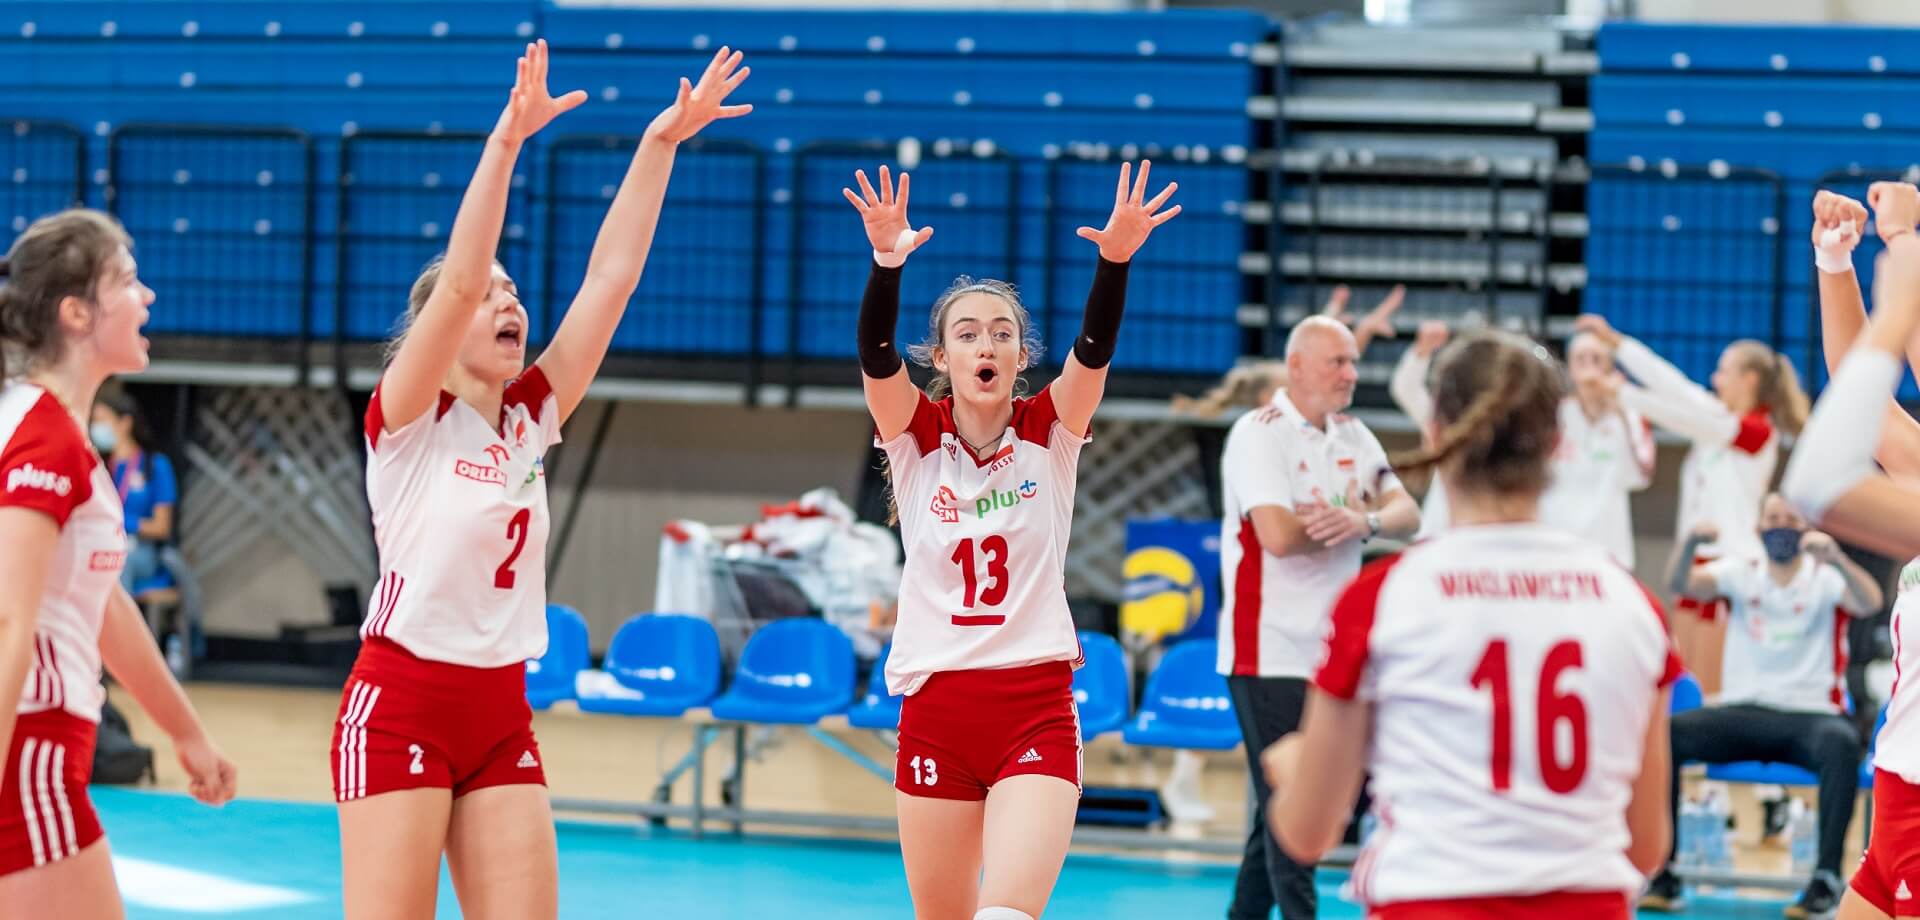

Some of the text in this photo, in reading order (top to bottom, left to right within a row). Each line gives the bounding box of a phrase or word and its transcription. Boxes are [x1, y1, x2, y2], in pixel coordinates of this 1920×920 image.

[7, 463, 58, 492] plus
[987, 455, 1014, 476] OLSK
[976, 489, 1020, 519] plus
[495, 508, 530, 589] 2
[951, 535, 1009, 608] 13
[1470, 639, 1588, 794] 16
[408, 744, 424, 774] 2
[910, 756, 938, 786] 13
